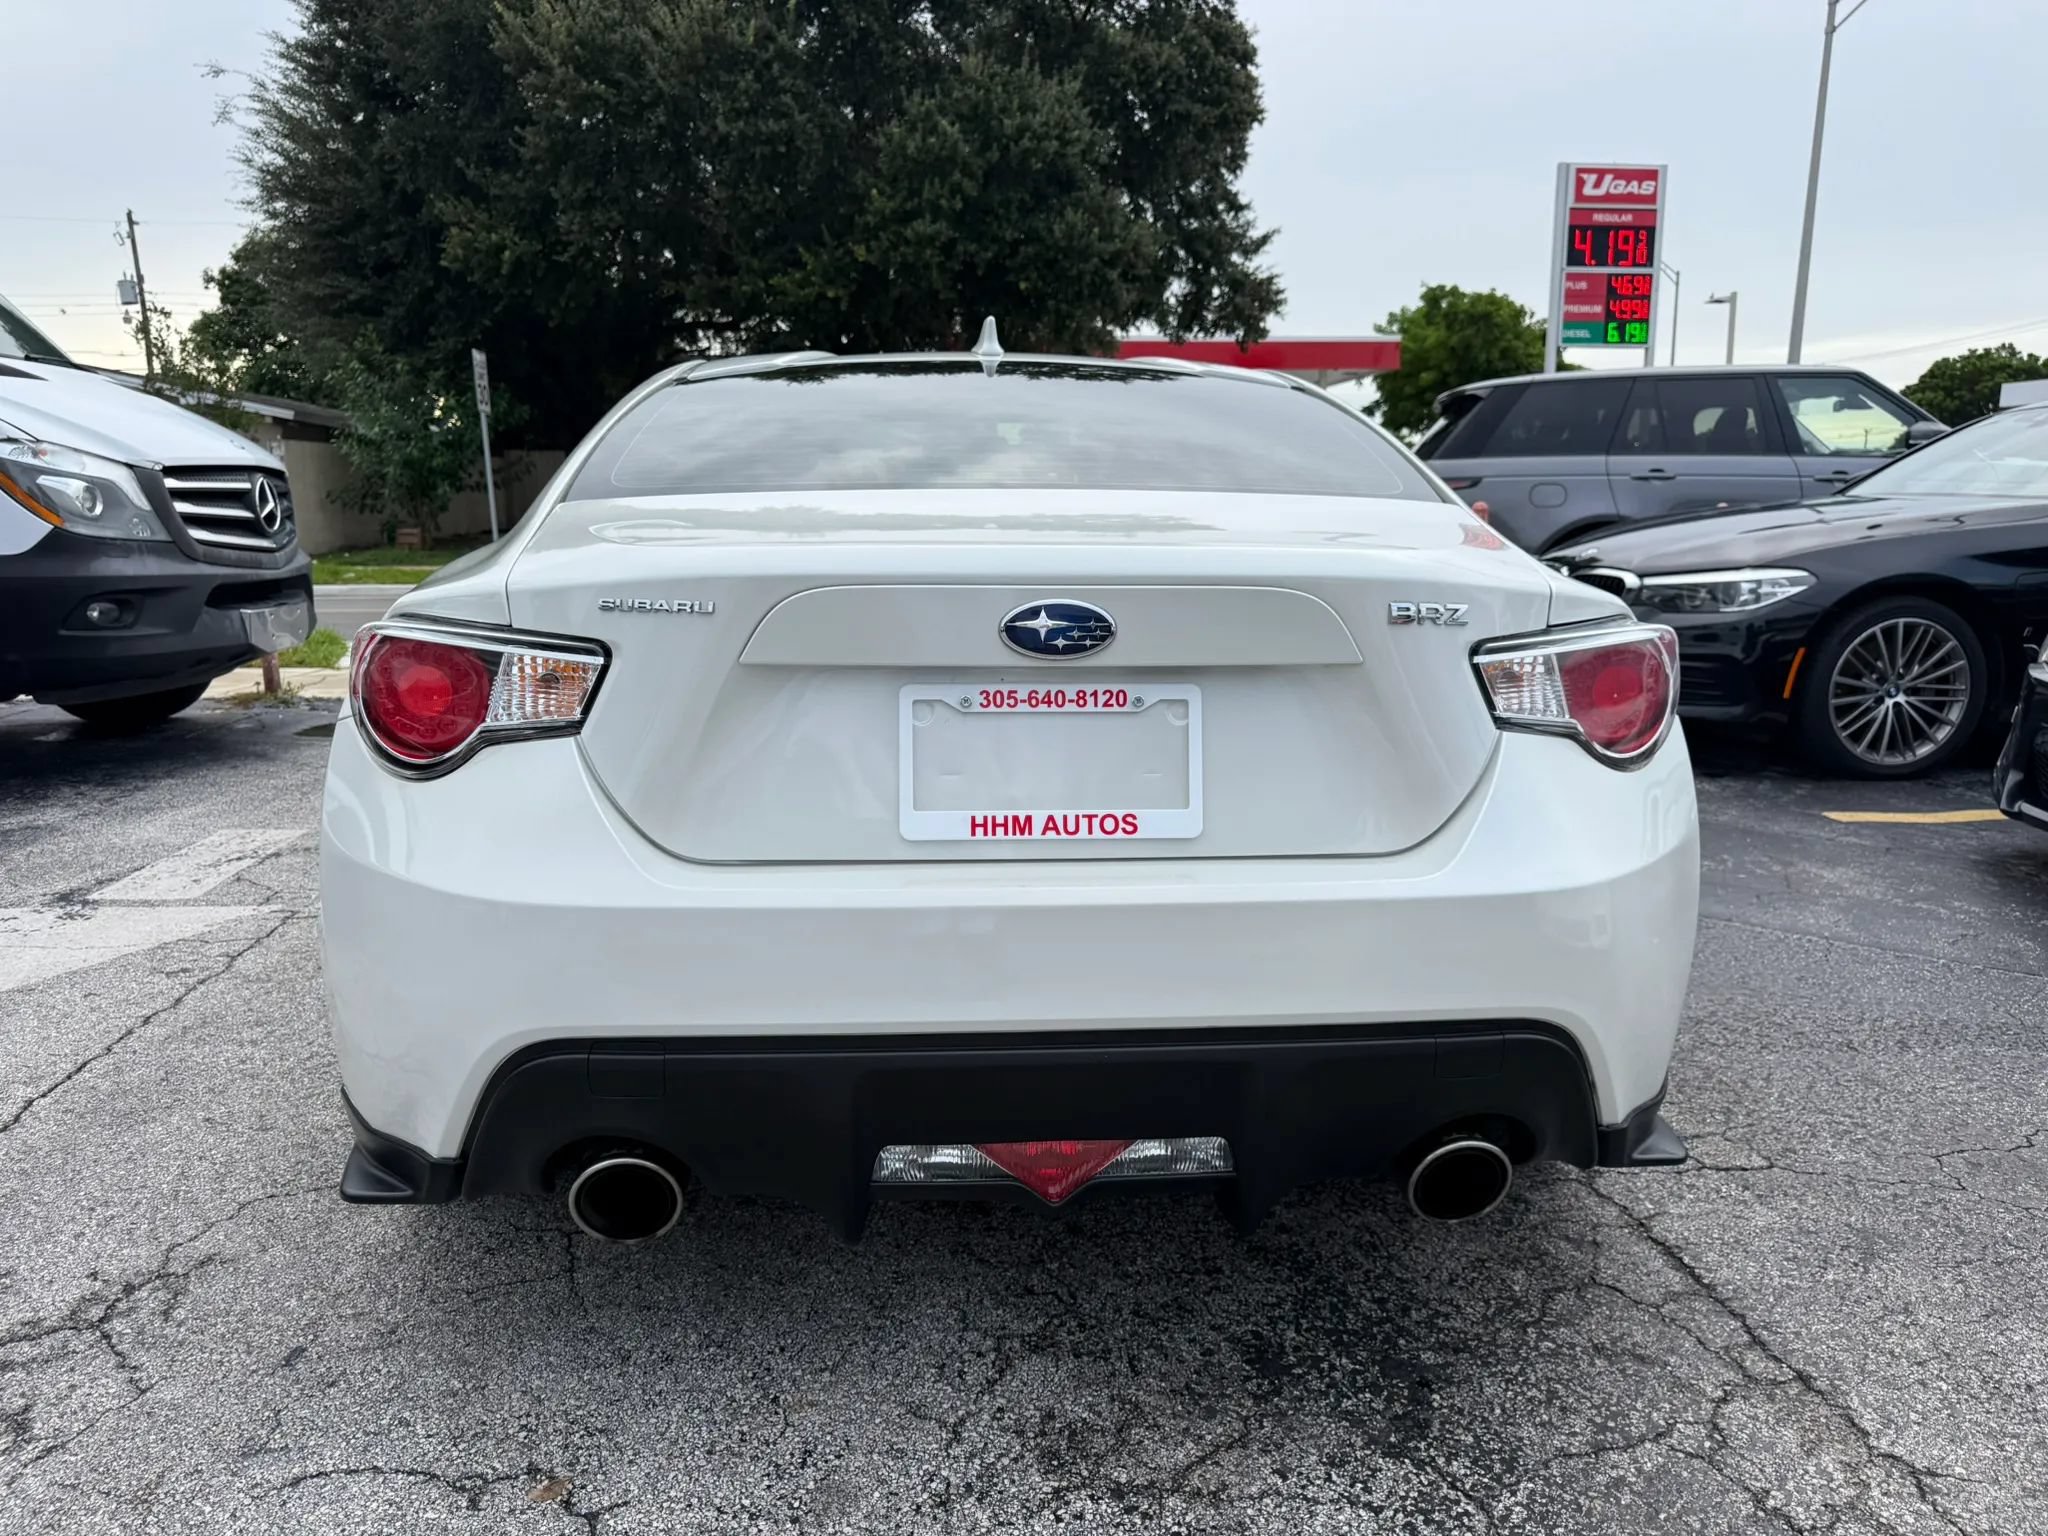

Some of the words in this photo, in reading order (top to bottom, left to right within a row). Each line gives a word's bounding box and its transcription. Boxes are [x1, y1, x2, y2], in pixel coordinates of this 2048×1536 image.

[1592, 212, 1634, 223] REGULAR
[1565, 280, 1588, 290] PLUS
[1564, 304, 1603, 313] PREMIUM
[1562, 329, 1591, 339] DIESEL
[598, 598, 715, 613] SUBARU
[1388, 601, 1469, 625] BRZ
[978, 689, 1128, 709] 305-640-8120
[970, 815, 1033, 837] HHM
[1041, 813, 1139, 836] AUTOS
